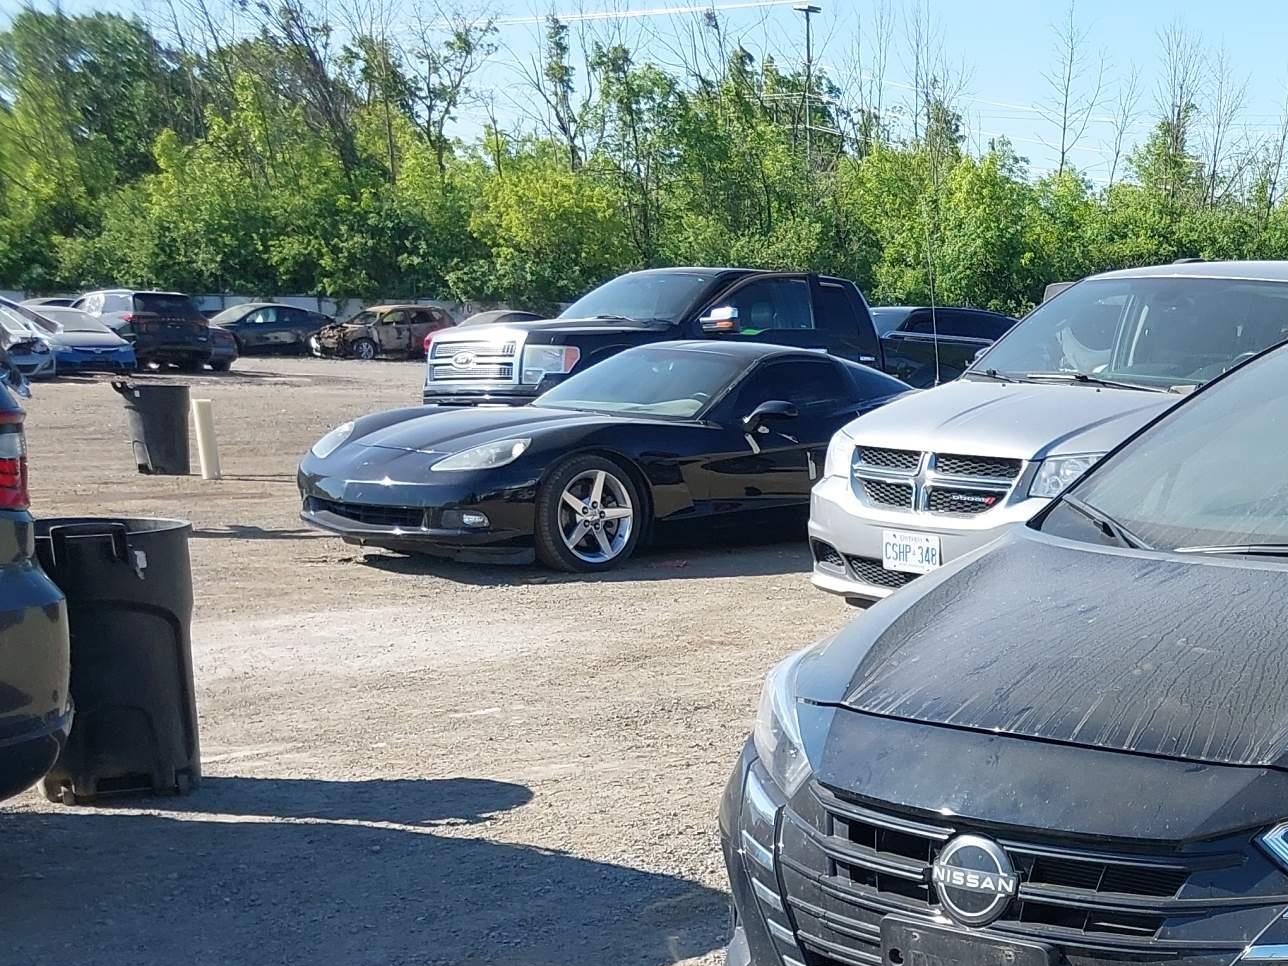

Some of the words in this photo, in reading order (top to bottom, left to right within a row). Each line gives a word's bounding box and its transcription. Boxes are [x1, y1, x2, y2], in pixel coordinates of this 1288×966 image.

[885, 541, 912, 563] CSHP
[917, 545, 937, 566] 348
[933, 865, 1014, 893] NISSAN
